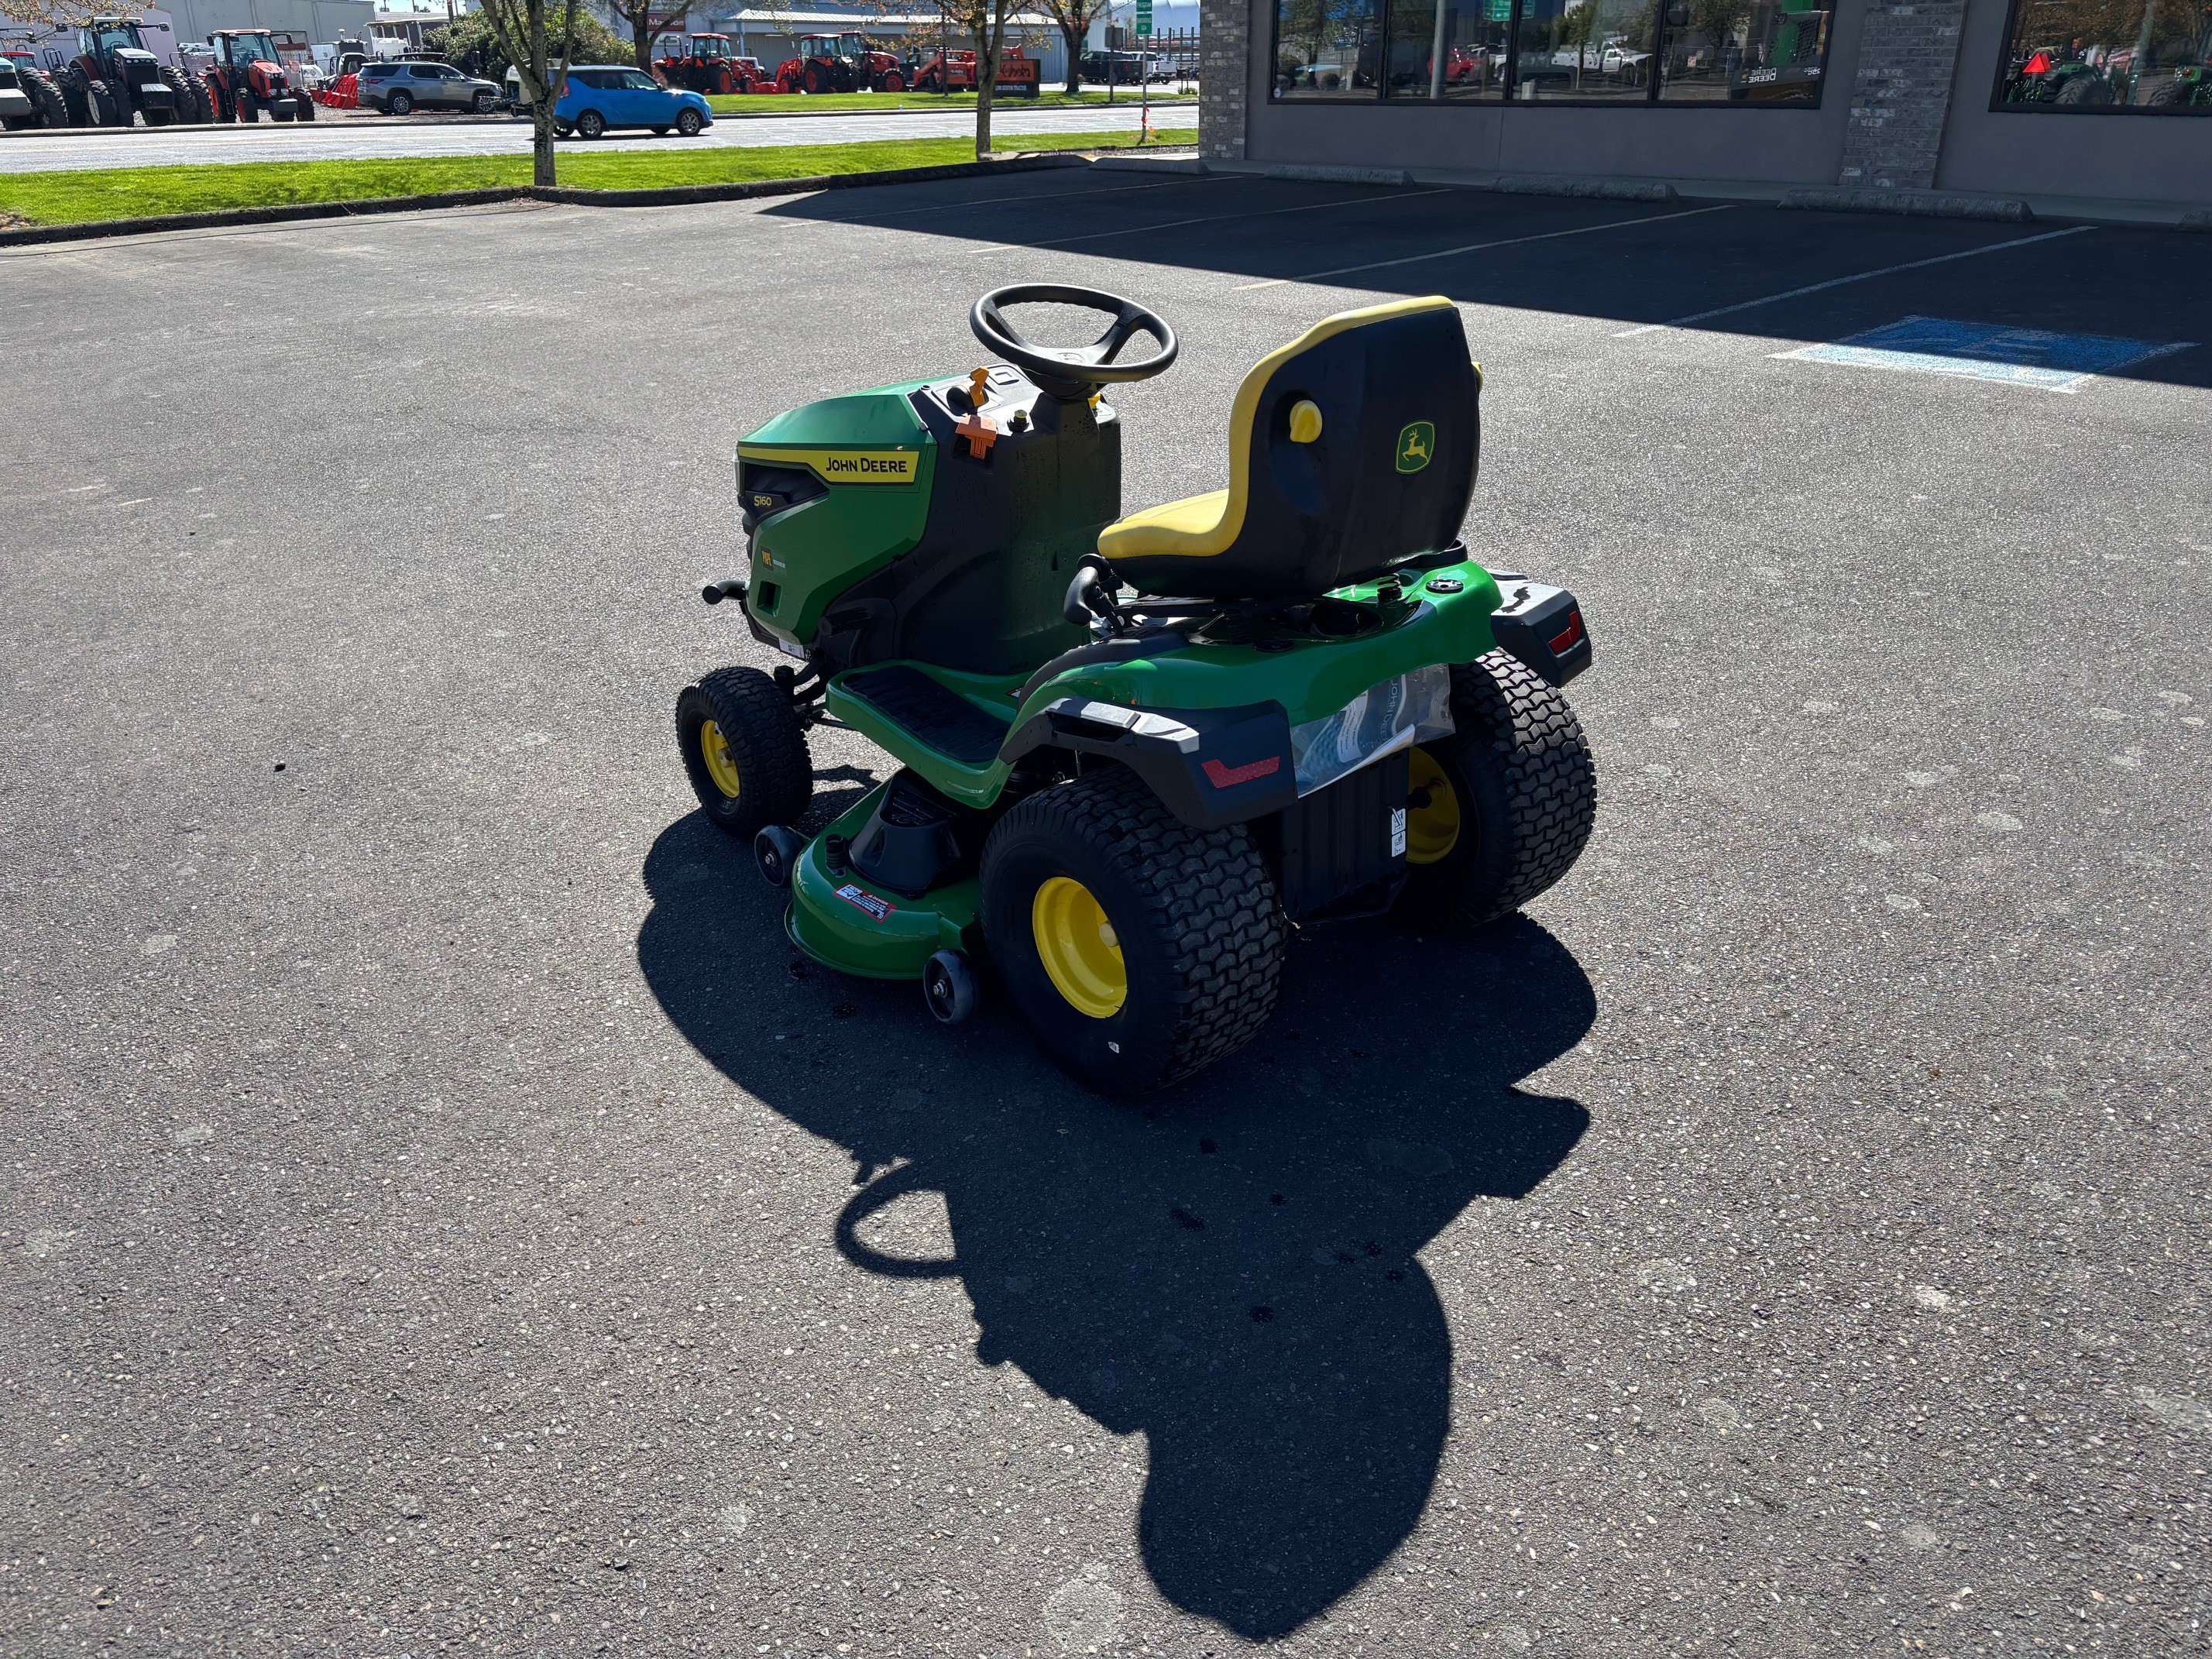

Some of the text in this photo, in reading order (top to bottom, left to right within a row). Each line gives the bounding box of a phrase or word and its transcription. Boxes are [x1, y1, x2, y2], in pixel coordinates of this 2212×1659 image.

[826, 457, 908, 473] JOHN DEERE
[754, 495, 772, 507] S160
[1387, 679, 1398, 713] JOHN
